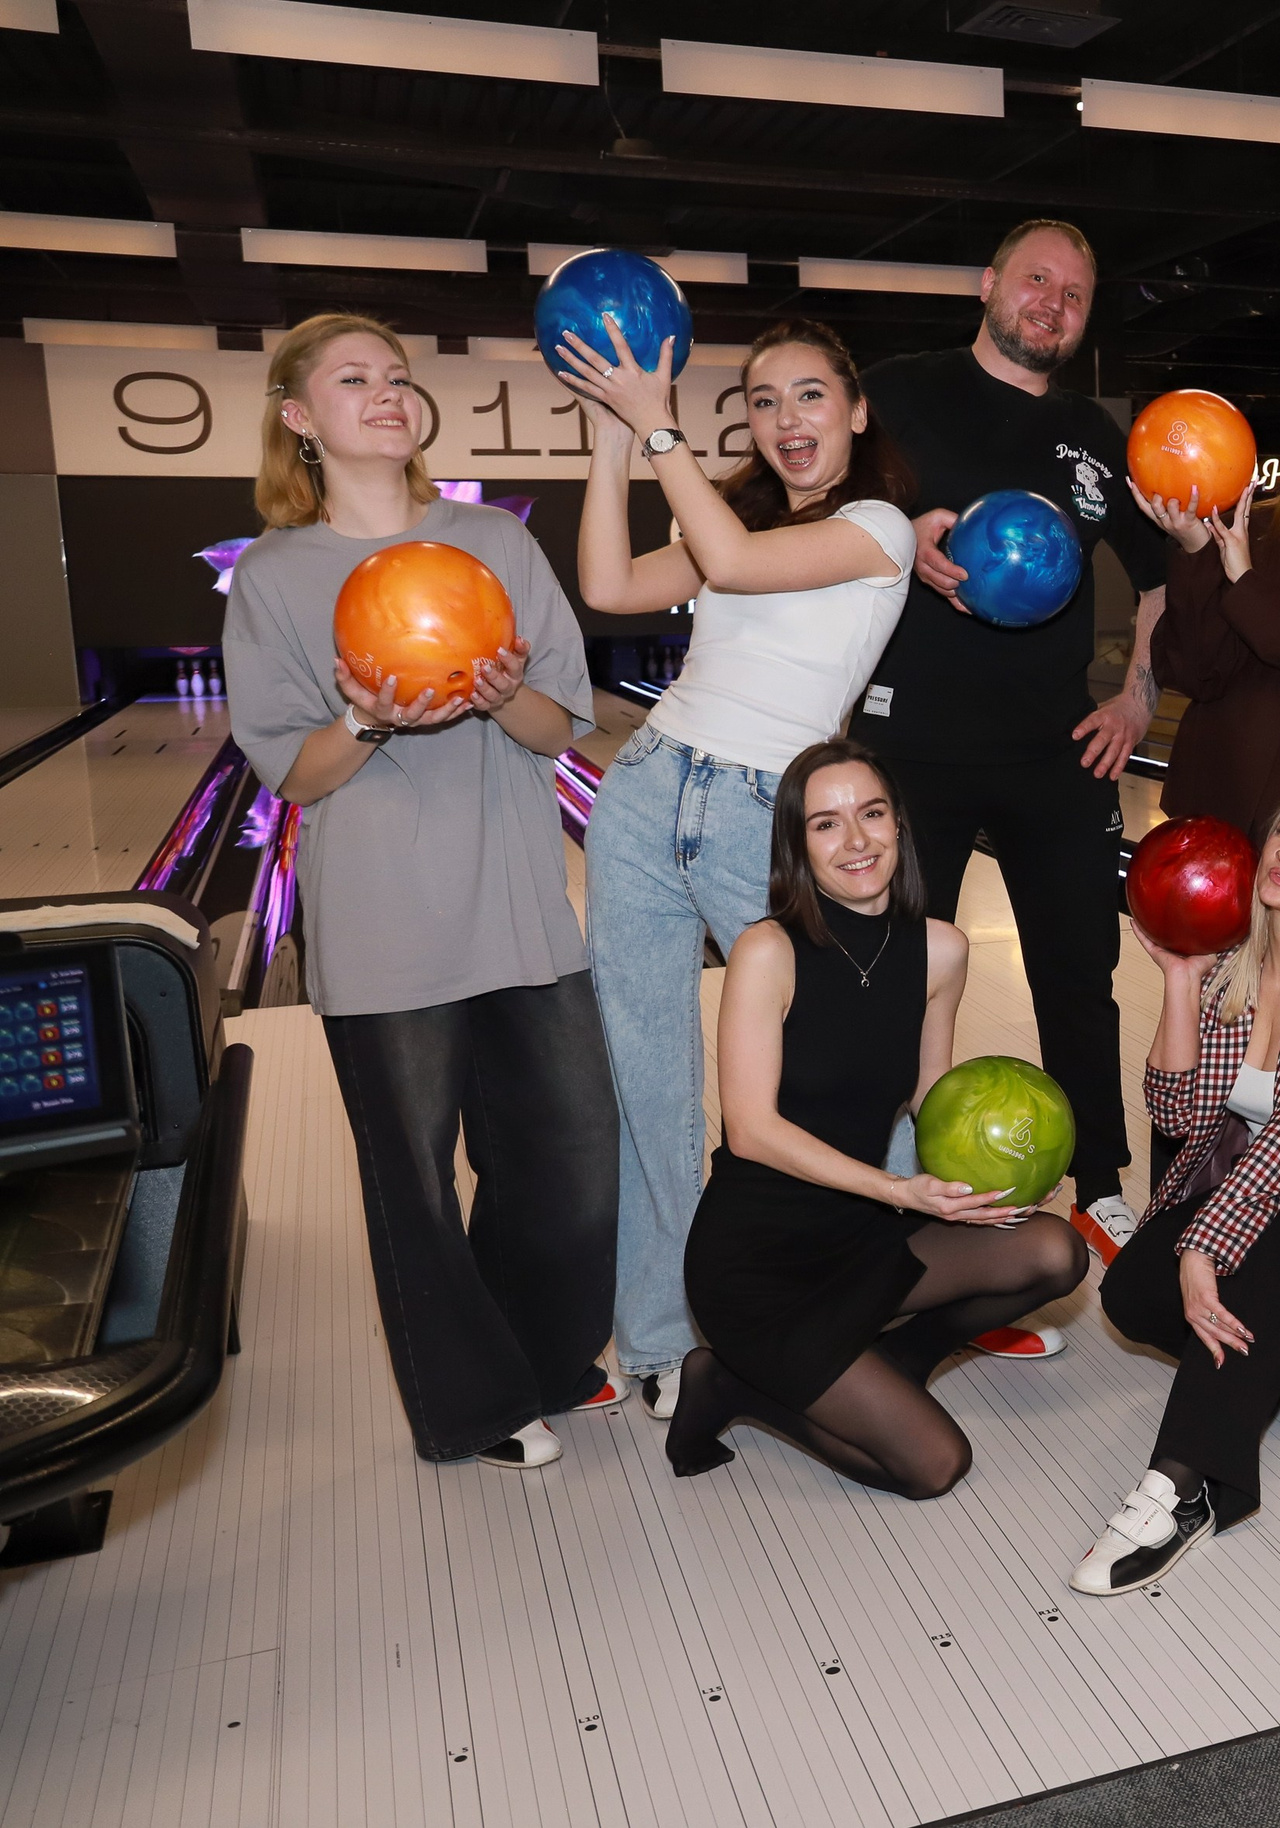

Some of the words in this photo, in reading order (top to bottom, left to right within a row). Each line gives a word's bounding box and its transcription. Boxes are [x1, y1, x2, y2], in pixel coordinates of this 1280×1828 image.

[112, 370, 213, 455] 9
[1168, 420, 1188, 446] 8
[1056, 443, 1088, 461] Don't
[1087, 457, 1113, 479] worry
[347, 650, 372, 678] 8
[1008, 1117, 1034, 1148] 6
[1028, 1145, 1036, 1154] S
[1148, 1509, 1159, 1523] STRIKE
[1038, 1607, 1058, 1616] R10
[931, 1633, 952, 1641] R15
[702, 1686, 723, 1695] L15
[577, 1714, 600, 1724] L10
